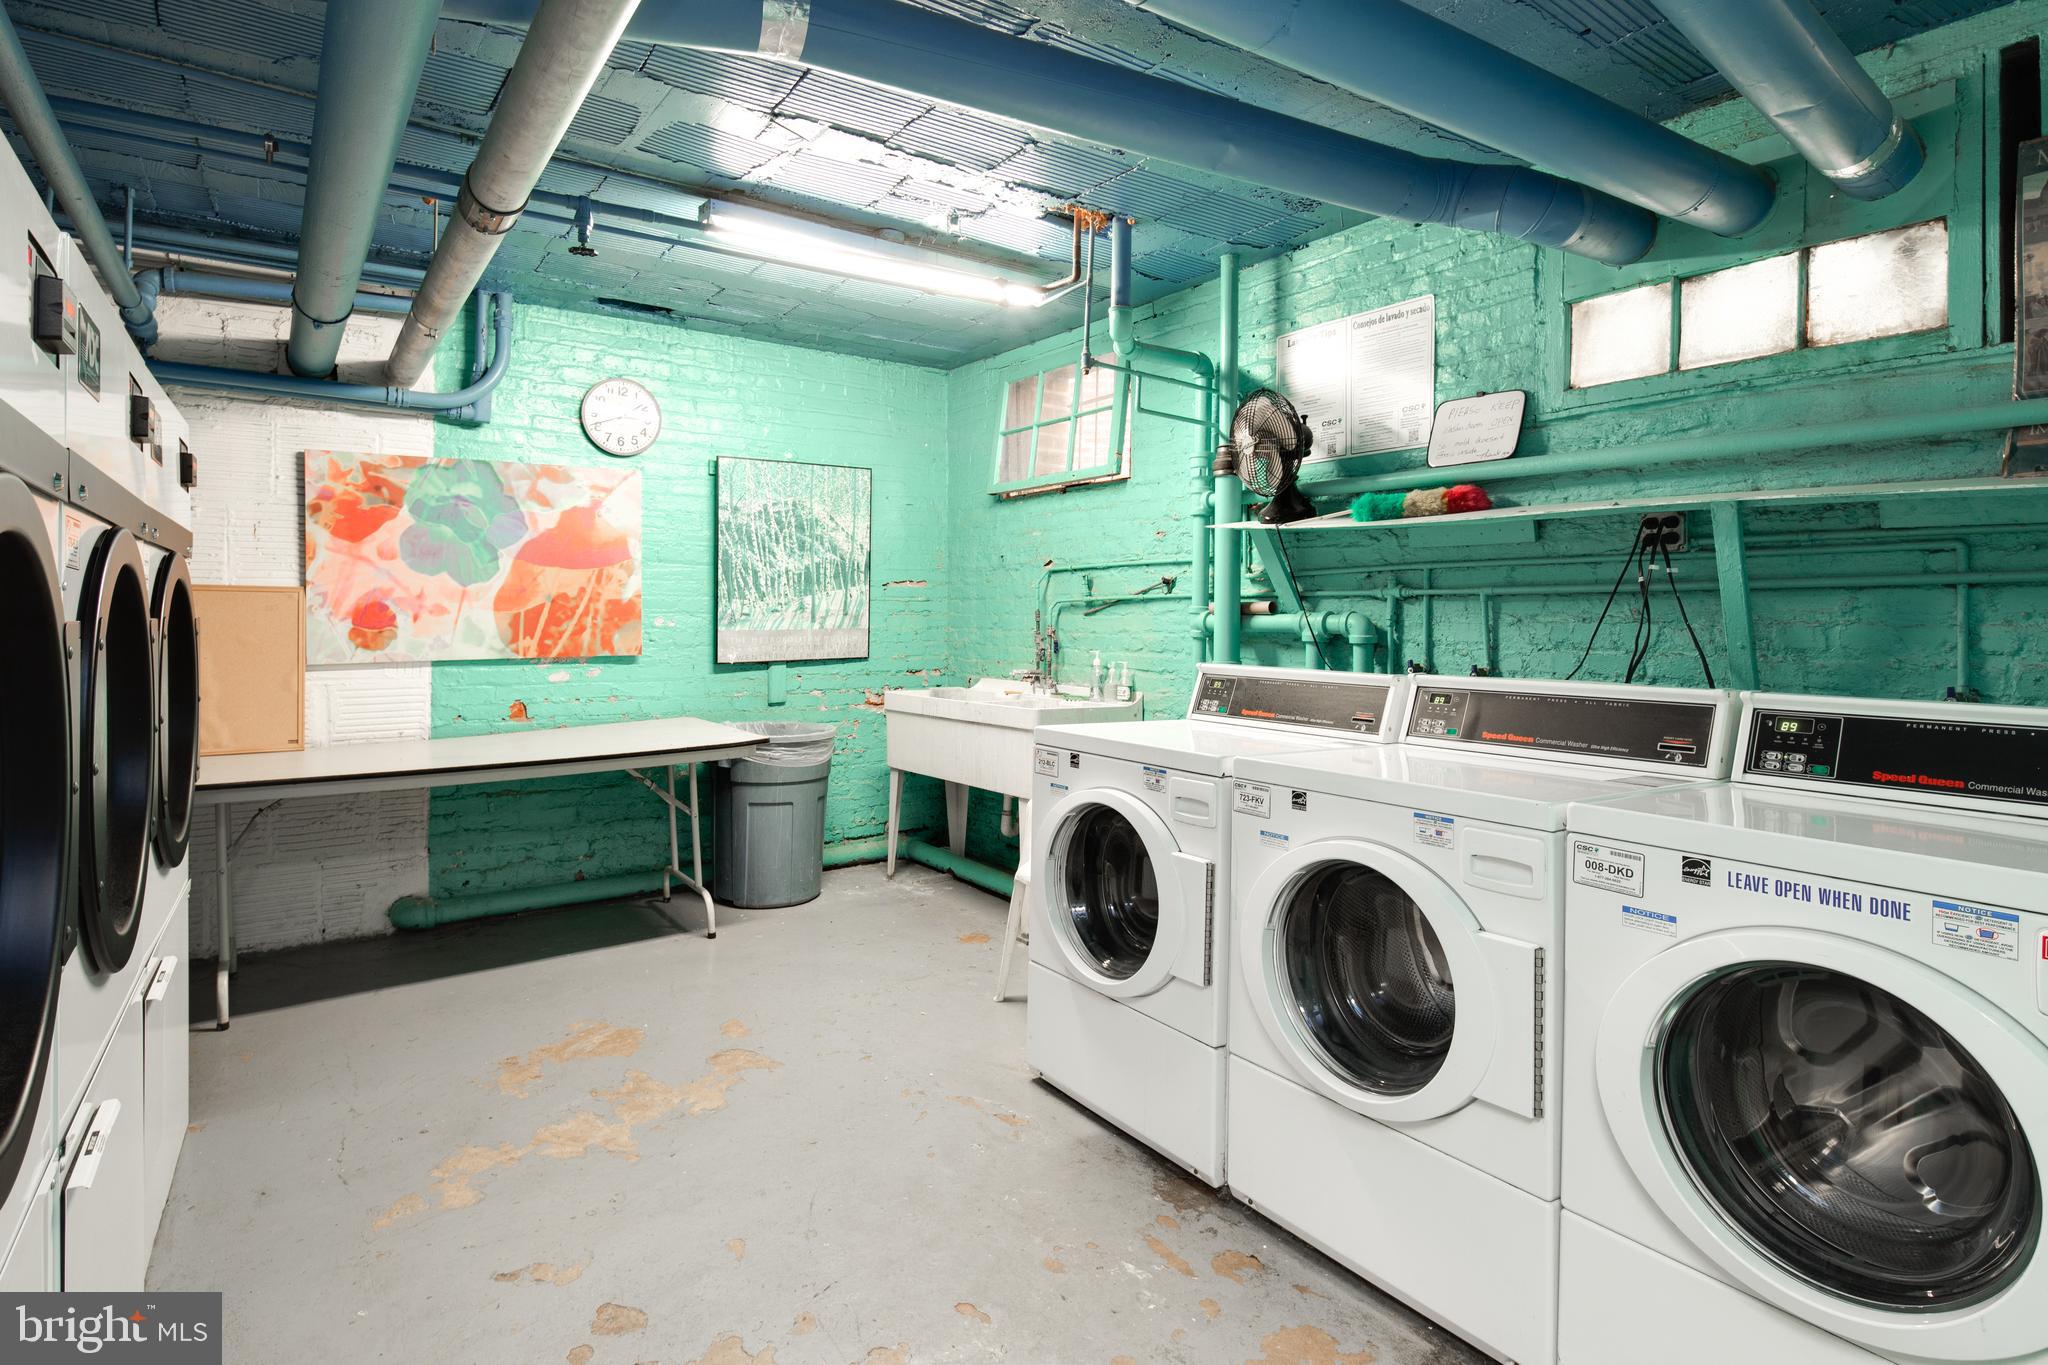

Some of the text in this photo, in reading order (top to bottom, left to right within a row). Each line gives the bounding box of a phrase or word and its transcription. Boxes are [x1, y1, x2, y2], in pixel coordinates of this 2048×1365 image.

[1378, 315, 1385, 324] de
[1386, 309, 1404, 322] lavado
[1405, 310, 1409, 319] y
[1410, 303, 1430, 315] secado
[618, 386, 628, 396] 12
[1490, 399, 1520, 411] KEEP
[1322, 419, 1337, 427] CSC
[640, 428, 647, 437] 4
[617, 436, 625, 446] 6
[631, 435, 639, 445] 5
[1780, 722, 1798, 732] 89
[1906, 723, 2016, 736] PERMANENT PRESS
[1482, 731, 1507, 740] Speed
[1508, 734, 1534, 743] Queen
[1536, 738, 1566, 746] Commercial
[1567, 741, 1588, 749] Washer
[1872, 770, 2048, 797] Speed Queen Commercial Was
[1576, 844, 1594, 852] CSC
[1585, 860, 1634, 878] 008-DKD
[1728, 870, 1911, 922] LEAVE OPEN WHEN DONE
[1630, 908, 1668, 920] NOTICE
[1958, 906, 1993, 917] NOTICE
